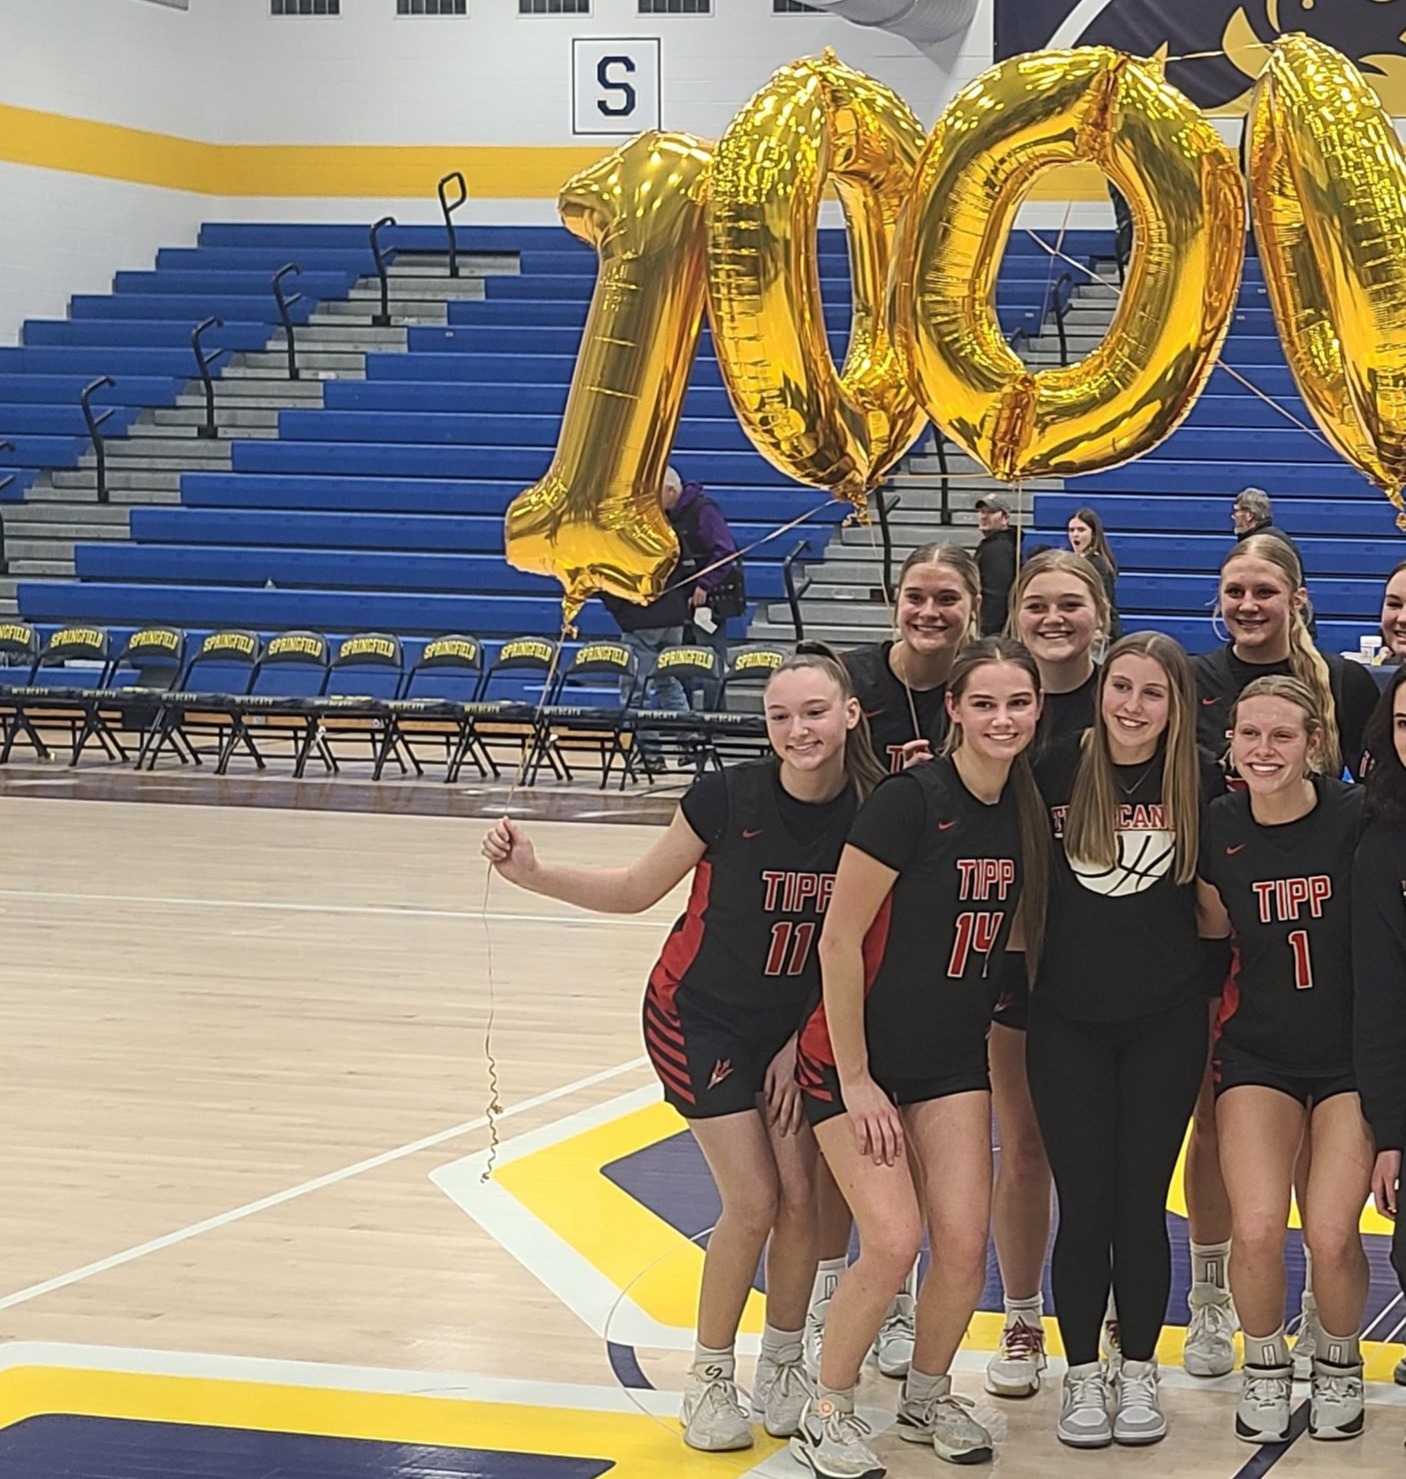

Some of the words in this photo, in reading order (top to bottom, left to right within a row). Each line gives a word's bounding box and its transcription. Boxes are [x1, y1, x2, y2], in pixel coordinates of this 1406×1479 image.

[597, 56, 635, 116] S
[51, 628, 103, 649] SPRINGFIELD
[129, 630, 179, 650] SPRINGFIELD
[203, 634, 254, 653] SPRINGFIELD
[268, 636, 323, 657] SPRINGFIELD
[341, 638, 396, 658] SPRINGFIELD
[423, 641, 476, 661] SPRINGFIELD
[500, 643, 552, 662] SPRINGFIELD
[576, 646, 629, 667] SPRINGFIELD
[658, 650, 714, 670] SPRINGFIELD
[956, 859, 1014, 900] TIPP
[1252, 875, 1332, 923] TIPP
[764, 922, 815, 976] 11
[947, 912, 1004, 978] 14
[1288, 930, 1313, 989] 1
